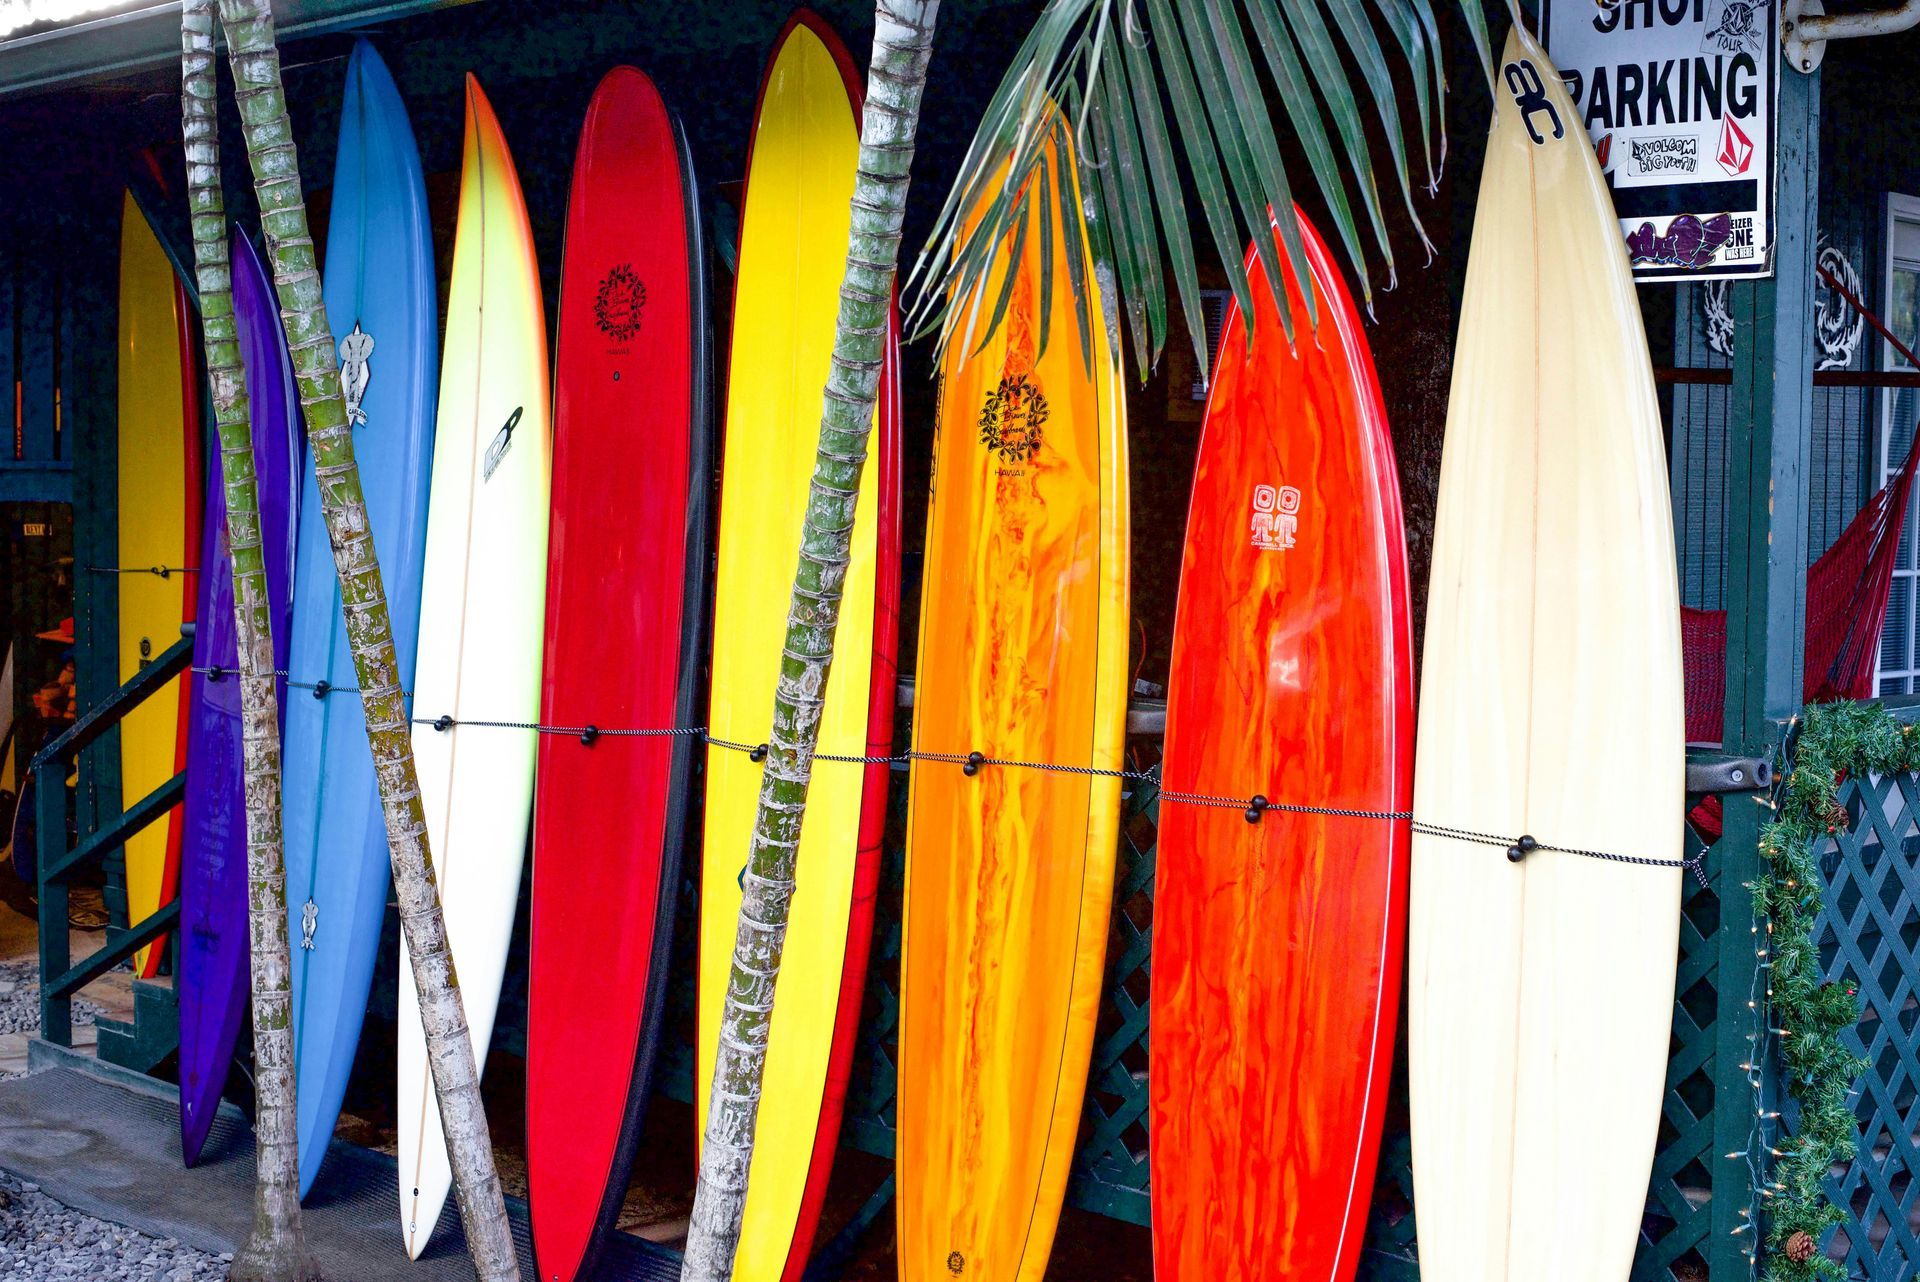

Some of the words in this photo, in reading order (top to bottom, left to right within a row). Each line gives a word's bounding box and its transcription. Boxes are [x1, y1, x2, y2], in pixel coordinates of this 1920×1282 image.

[1717, 33, 1743, 52] TOUR
[1558, 52, 1758, 130] PARKING
[1643, 138, 1696, 156] VOLCOM
[1725, 228, 1754, 248] ONE
